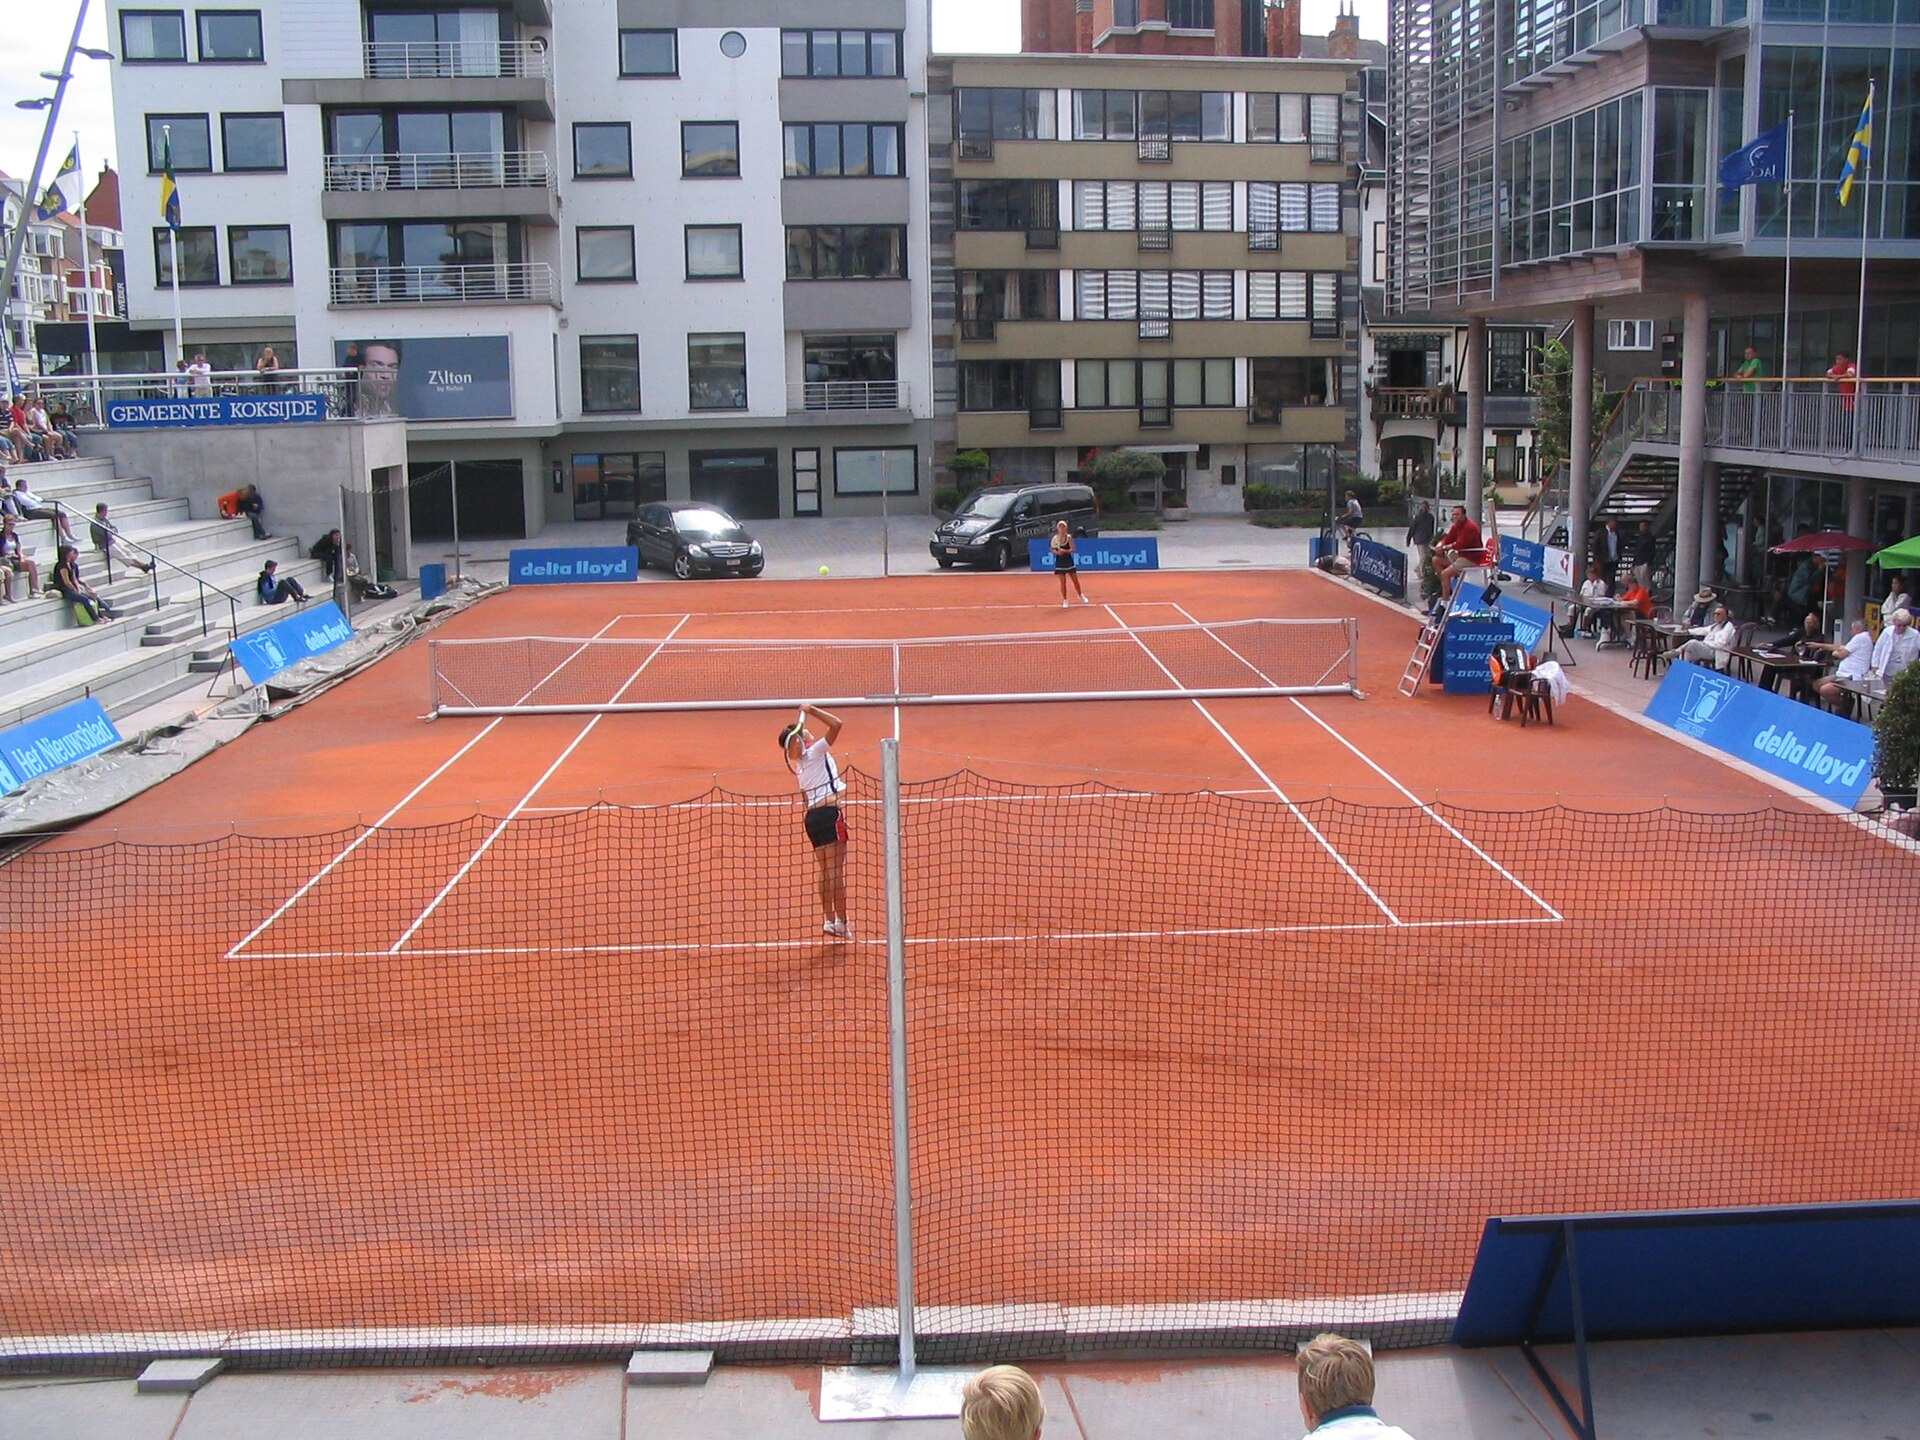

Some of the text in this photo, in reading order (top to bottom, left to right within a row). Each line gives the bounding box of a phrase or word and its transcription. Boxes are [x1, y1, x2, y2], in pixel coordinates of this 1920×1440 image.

[428, 370, 472, 385] Zilton
[111, 400, 318, 422] GEMEENTE KOKSIJDE
[1041, 550, 1147, 566] dta lloyd
[1513, 544, 1531, 558] Tennis
[521, 559, 627, 577] delta lloyd
[322, 618, 350, 643] lloyd
[1457, 633, 1512, 641] DUNLOP
[1456, 652, 1491, 660] DUN
[11, 747, 48, 779] Het
[35, 714, 115, 768] Nieuwsblad
[1753, 724, 1807, 765] delta
[1802, 741, 1866, 787] lloyd
